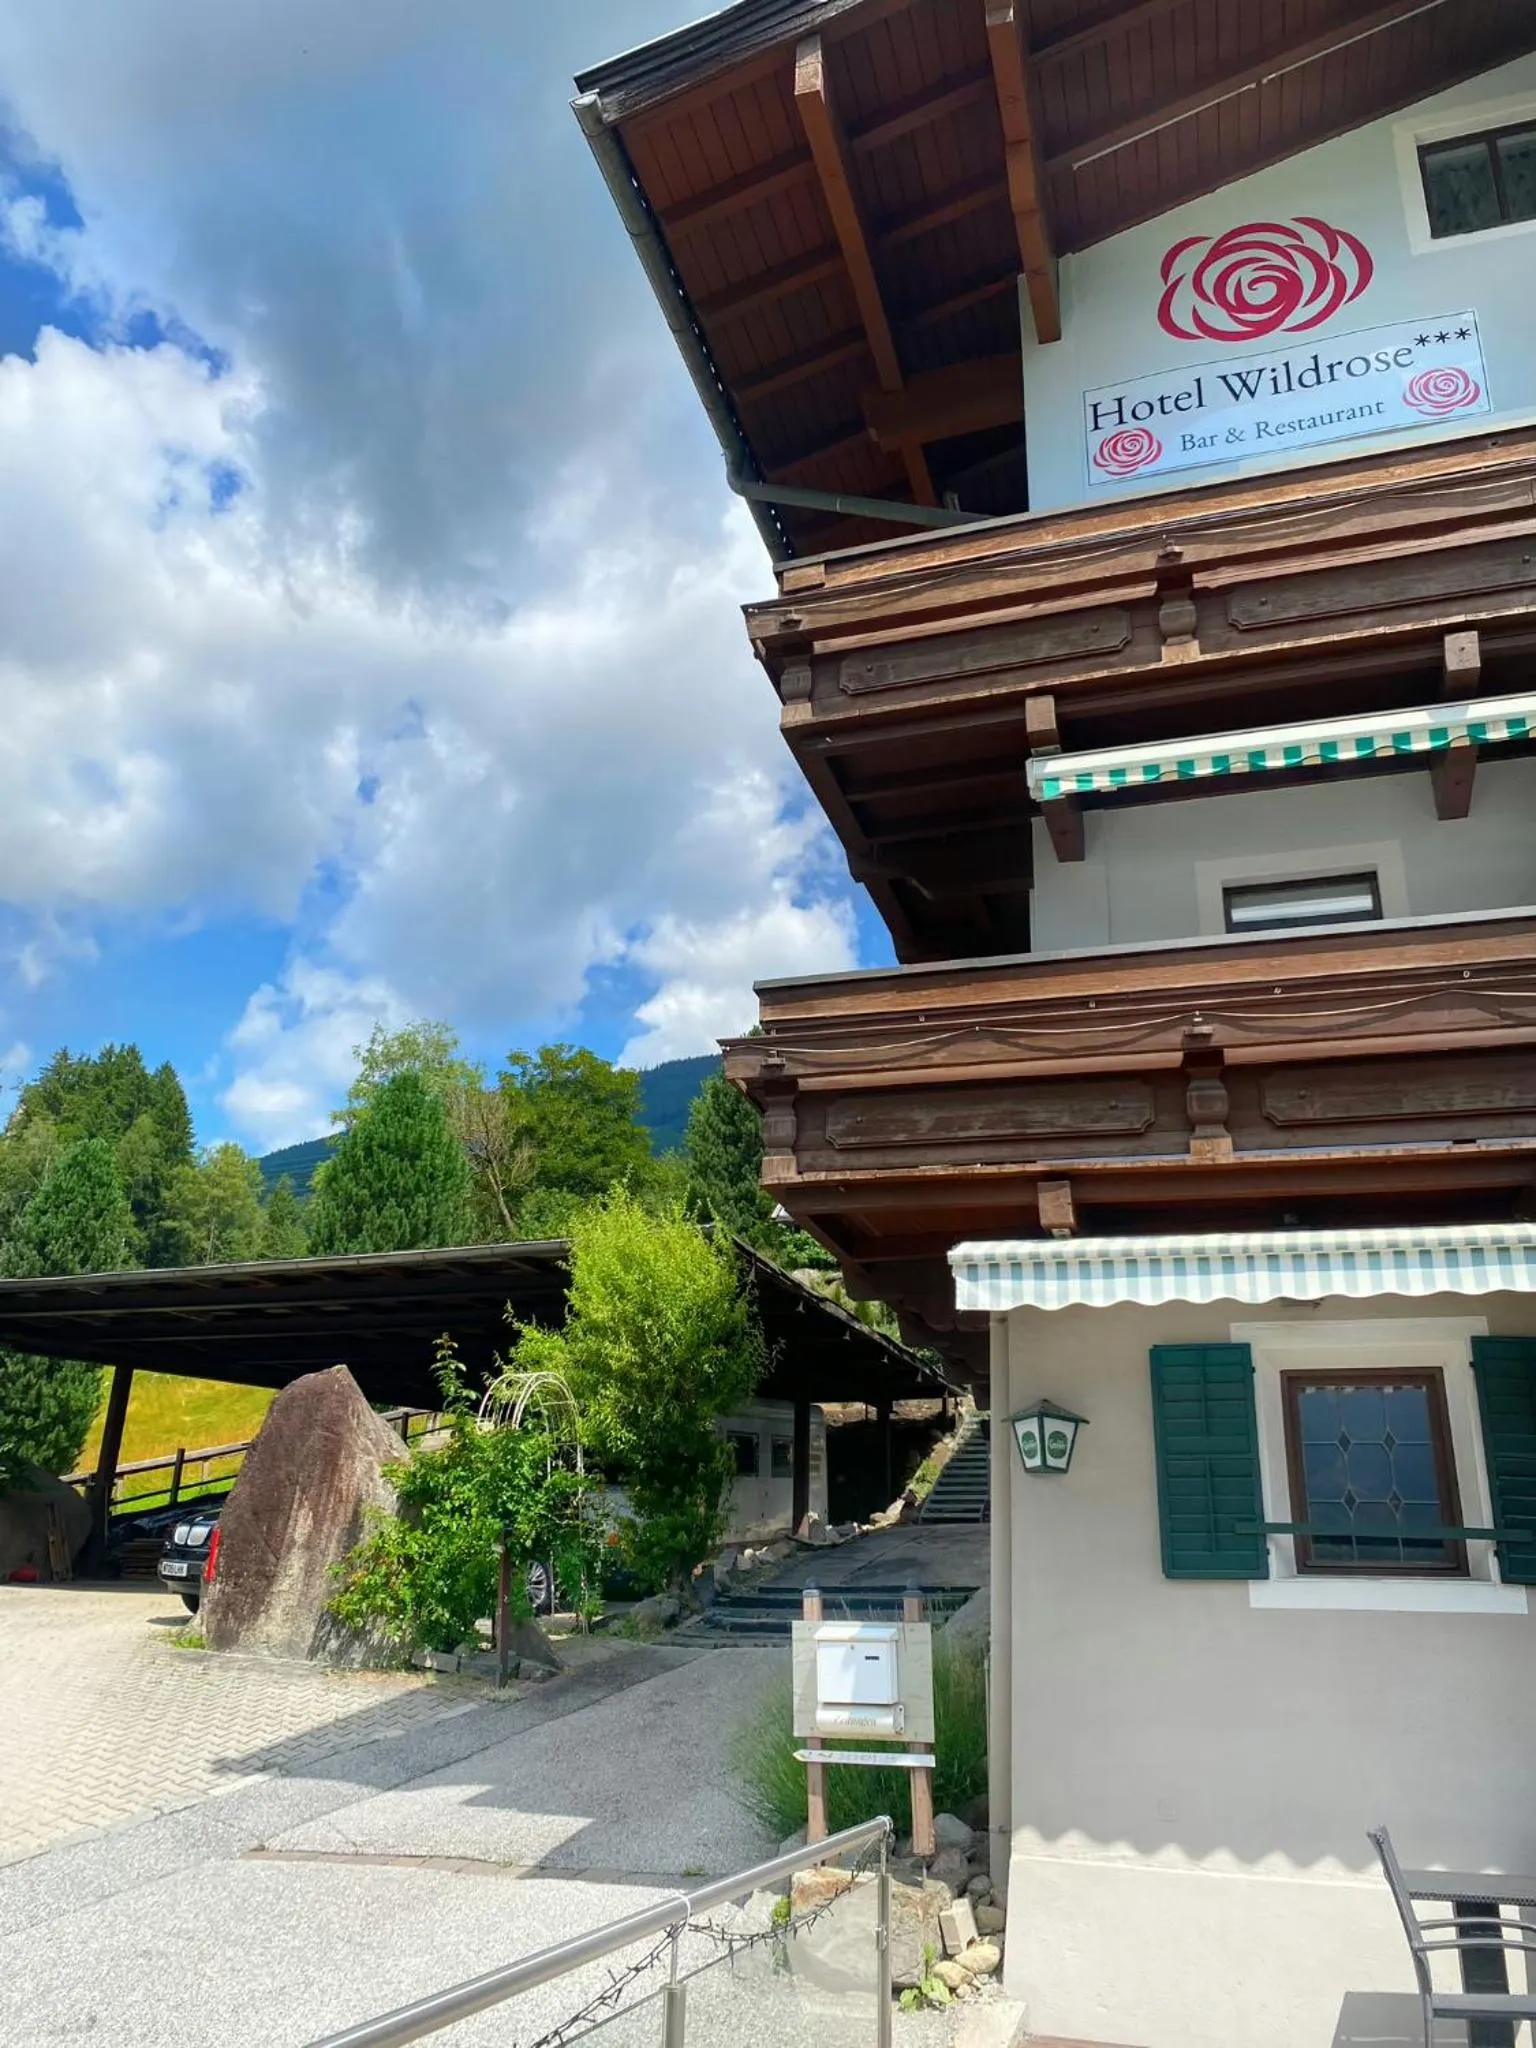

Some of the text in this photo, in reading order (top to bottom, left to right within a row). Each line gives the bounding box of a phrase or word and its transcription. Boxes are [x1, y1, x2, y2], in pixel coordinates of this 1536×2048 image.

[1088, 376, 1207, 433] Hotel
[1179, 400, 1386, 452] Bar & Restaurant
